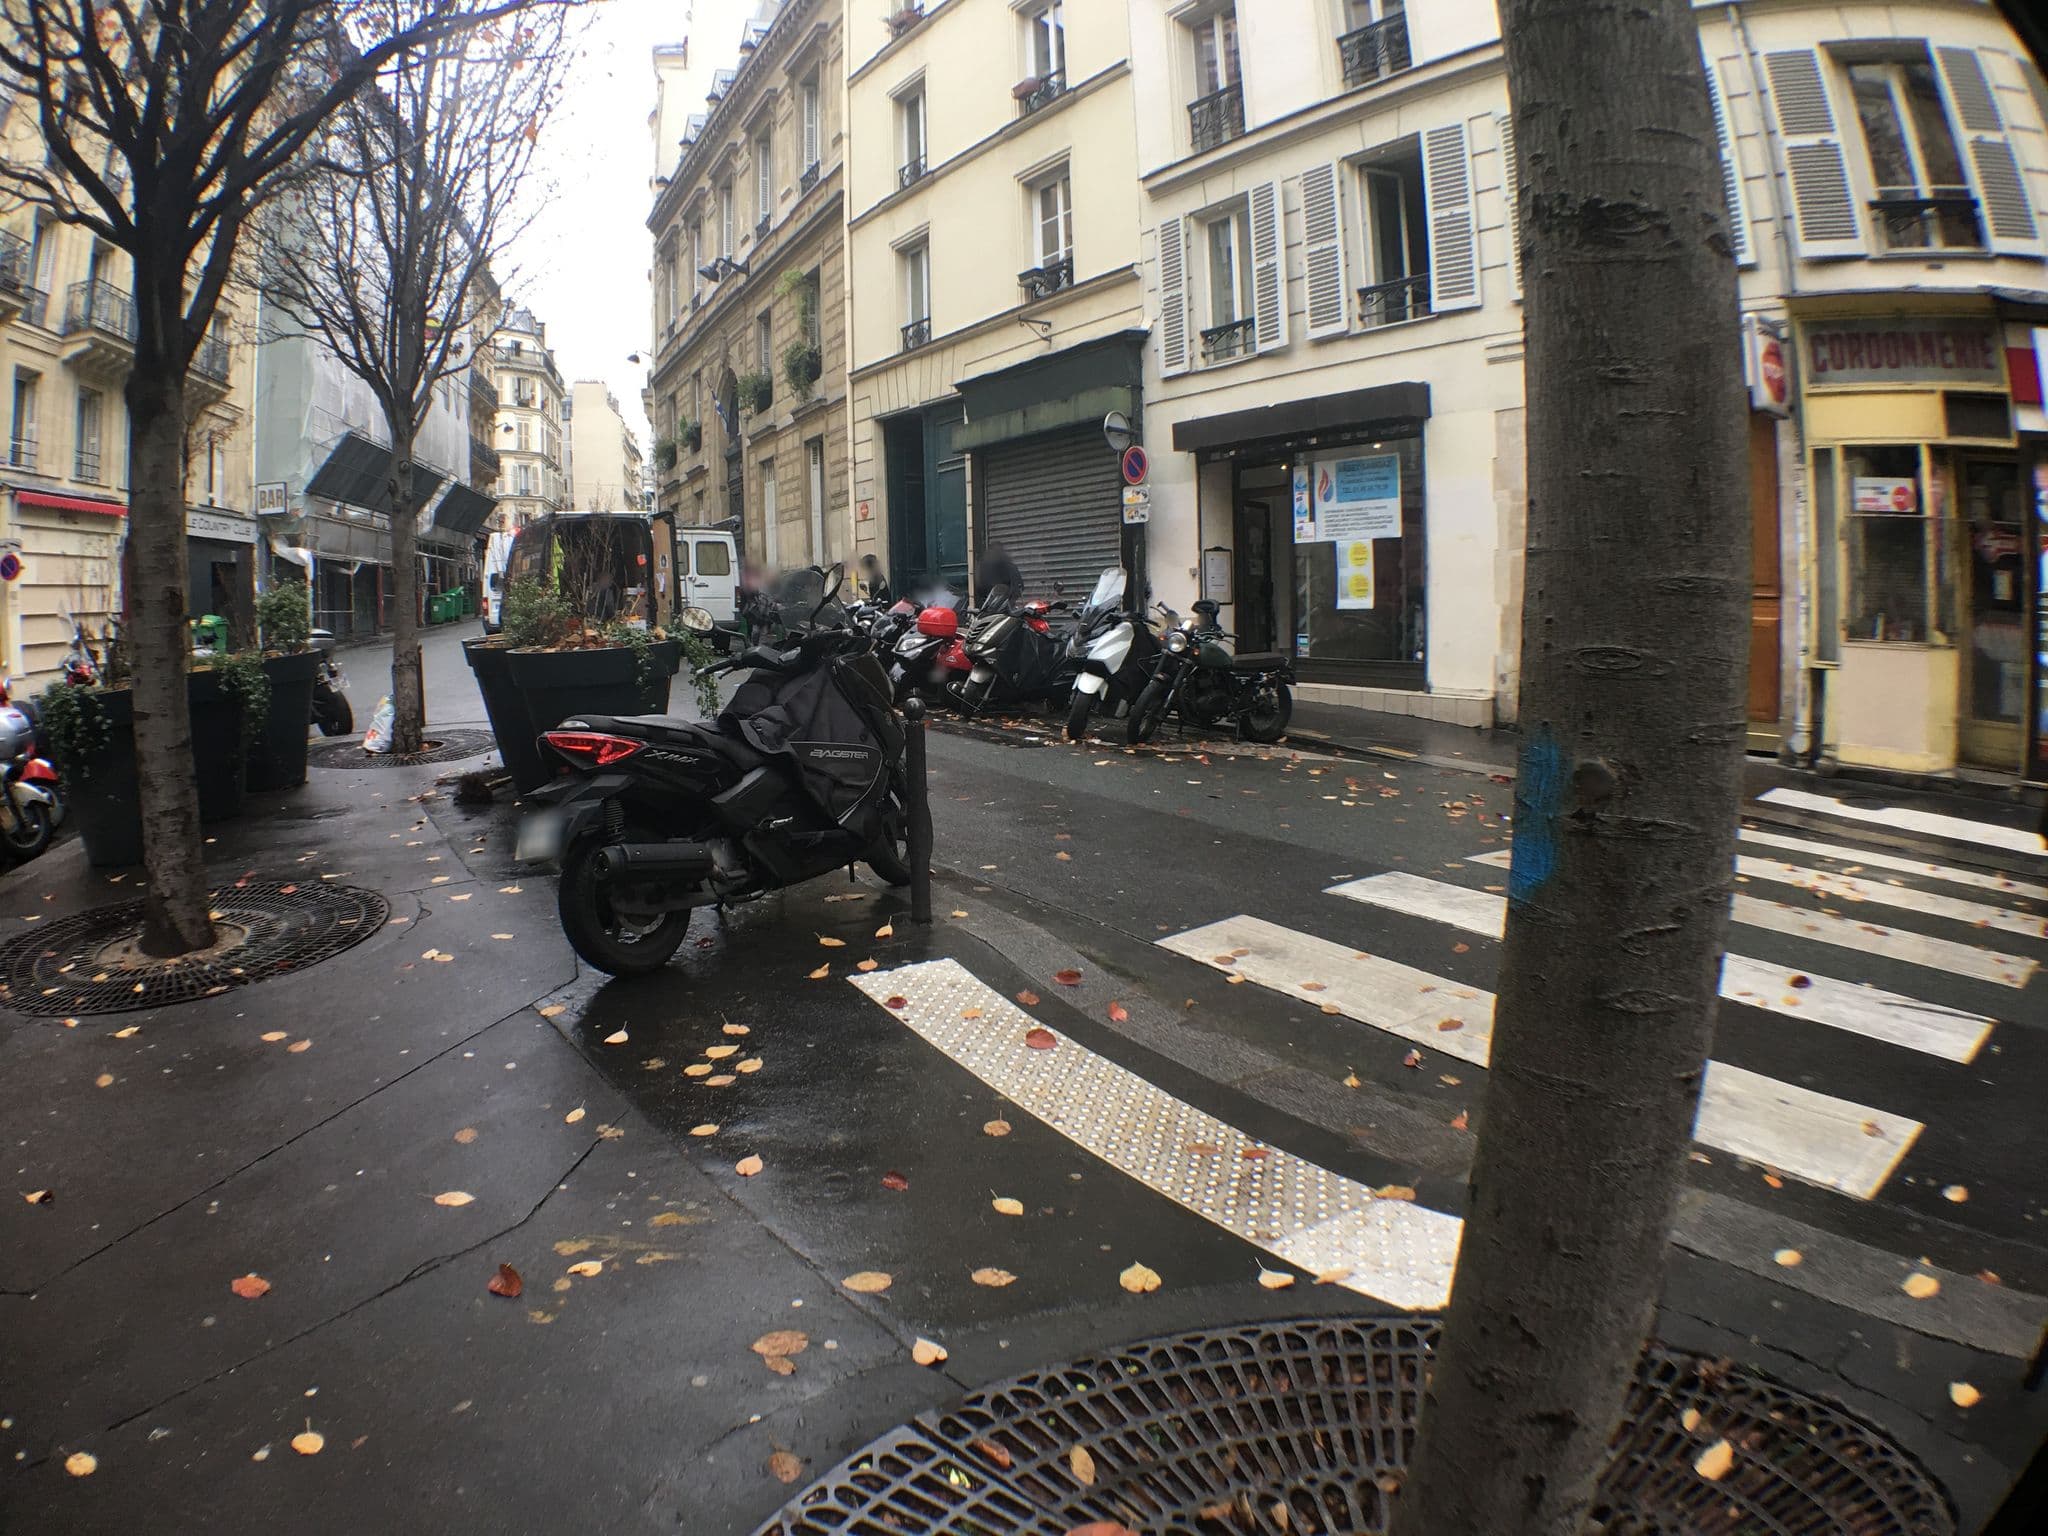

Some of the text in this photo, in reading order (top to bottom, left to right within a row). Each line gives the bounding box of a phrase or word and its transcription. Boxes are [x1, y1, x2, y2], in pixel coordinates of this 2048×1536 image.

[1810, 331, 1996, 372] CORDONNERIE
[259, 489, 284, 509] BAR
[809, 749, 869, 759] BAGSTER
